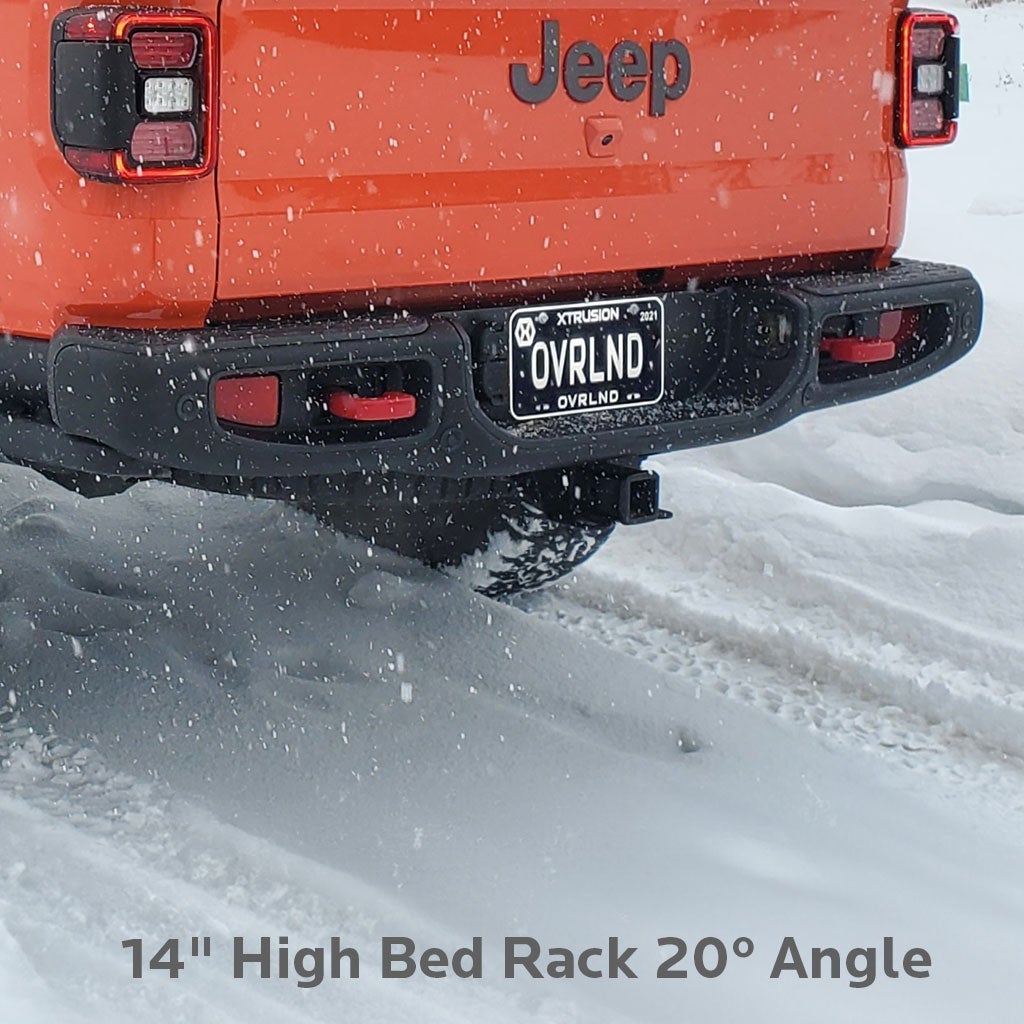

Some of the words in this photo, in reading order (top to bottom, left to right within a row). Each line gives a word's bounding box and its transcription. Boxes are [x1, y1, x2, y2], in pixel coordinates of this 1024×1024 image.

[509, 19, 692, 118] Jeep
[557, 306, 620, 326] XTRUSION
[639, 309, 658, 322] 2021
[531, 332, 644, 390] OVRLND
[557, 389, 619, 409] OVRLND
